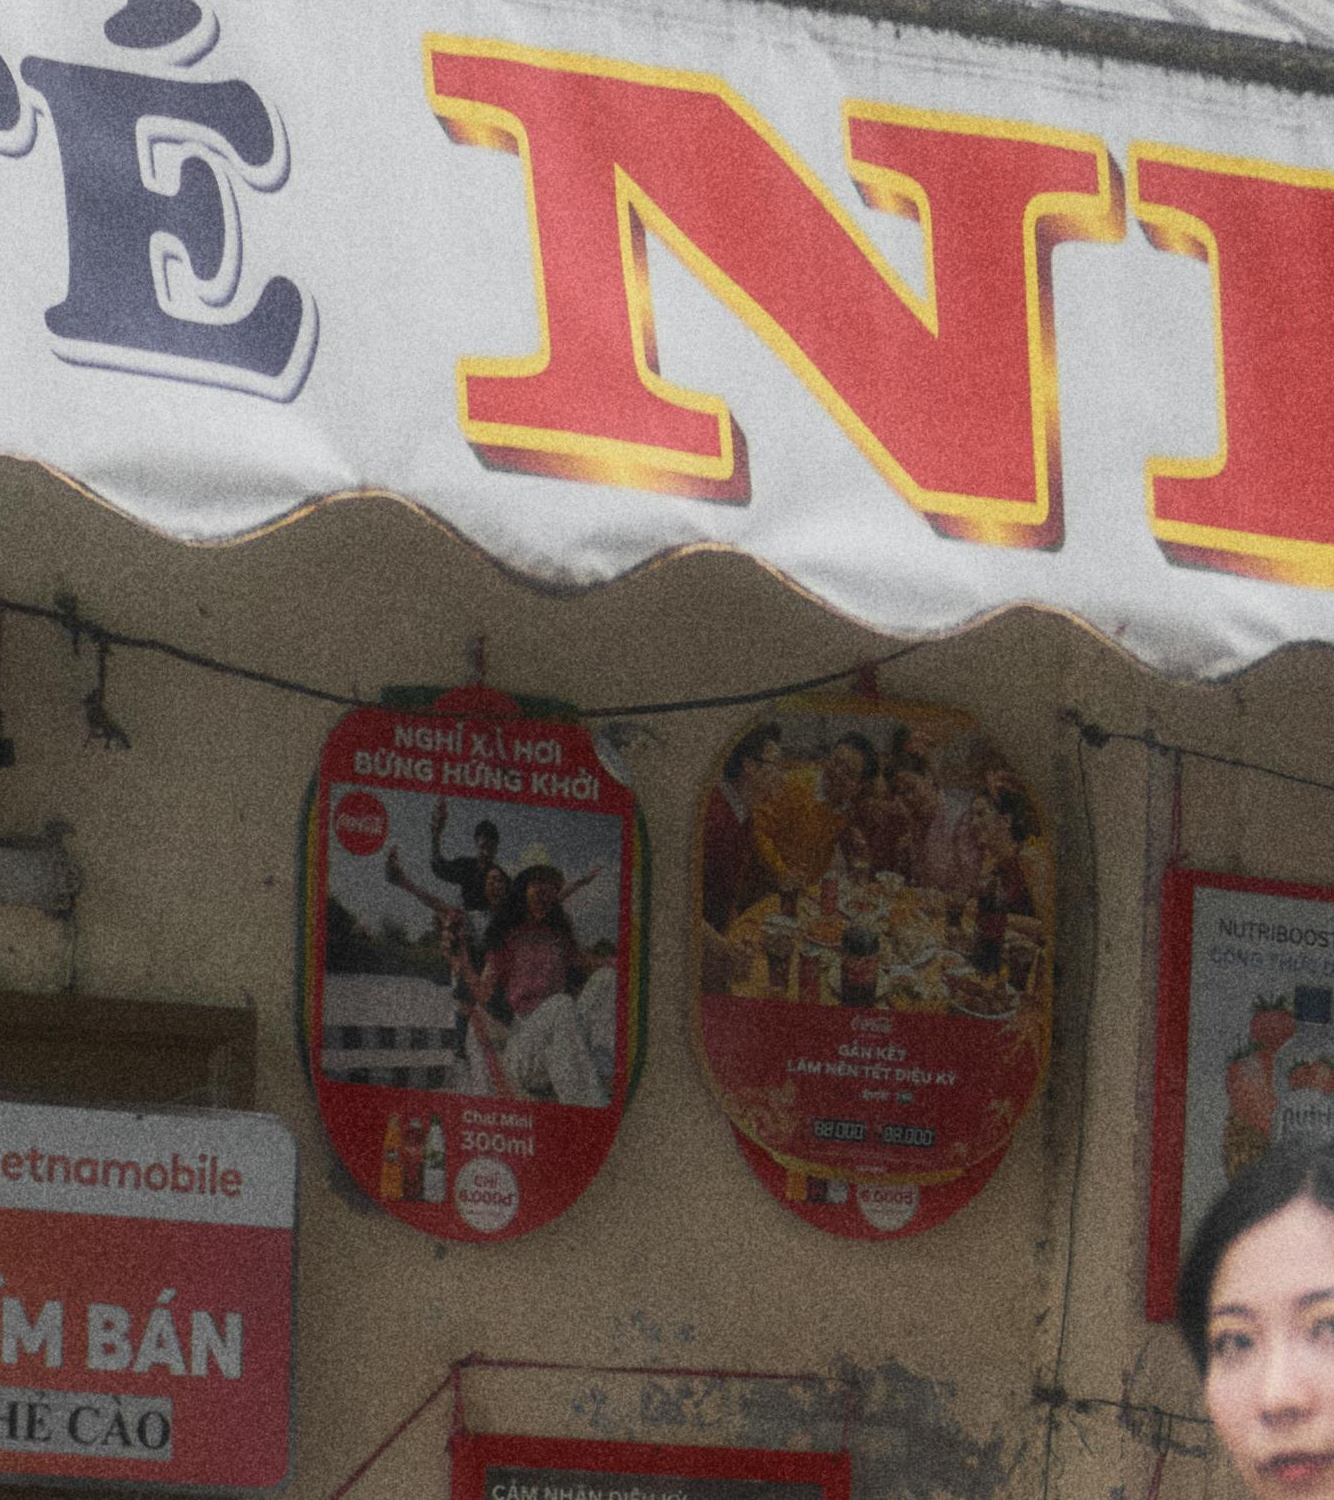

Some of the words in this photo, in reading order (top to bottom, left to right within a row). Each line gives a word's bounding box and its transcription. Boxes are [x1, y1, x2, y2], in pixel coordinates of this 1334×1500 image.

[394, 721, 464, 757] NGHỈ
[514, 736, 562, 767] HƠI
[460, 1129, 536, 1159] 300ml
[86, 1288, 244, 1380] BÁN
[67, 1396, 171, 1451] CÀO
